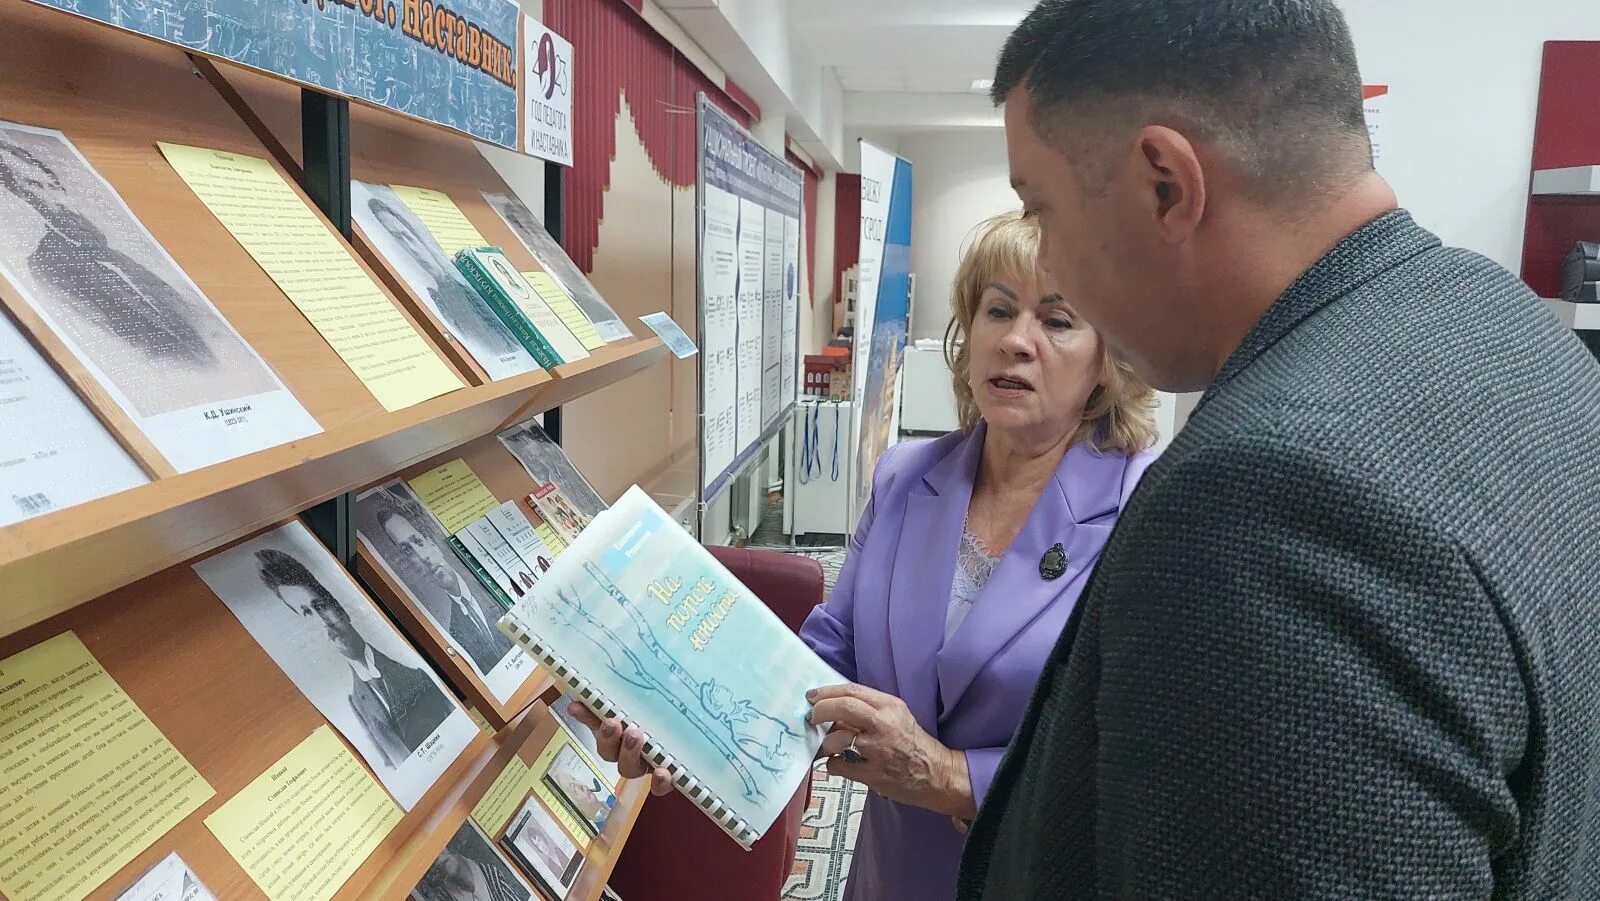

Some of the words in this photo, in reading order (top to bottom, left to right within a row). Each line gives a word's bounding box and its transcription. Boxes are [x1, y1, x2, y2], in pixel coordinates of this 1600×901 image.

[401, 0, 517, 90] Наставник.
[459, 252, 493, 297] КРУПСКАЯ
[219, 404, 252, 417] Ушинский
[646, 576, 683, 606] На
